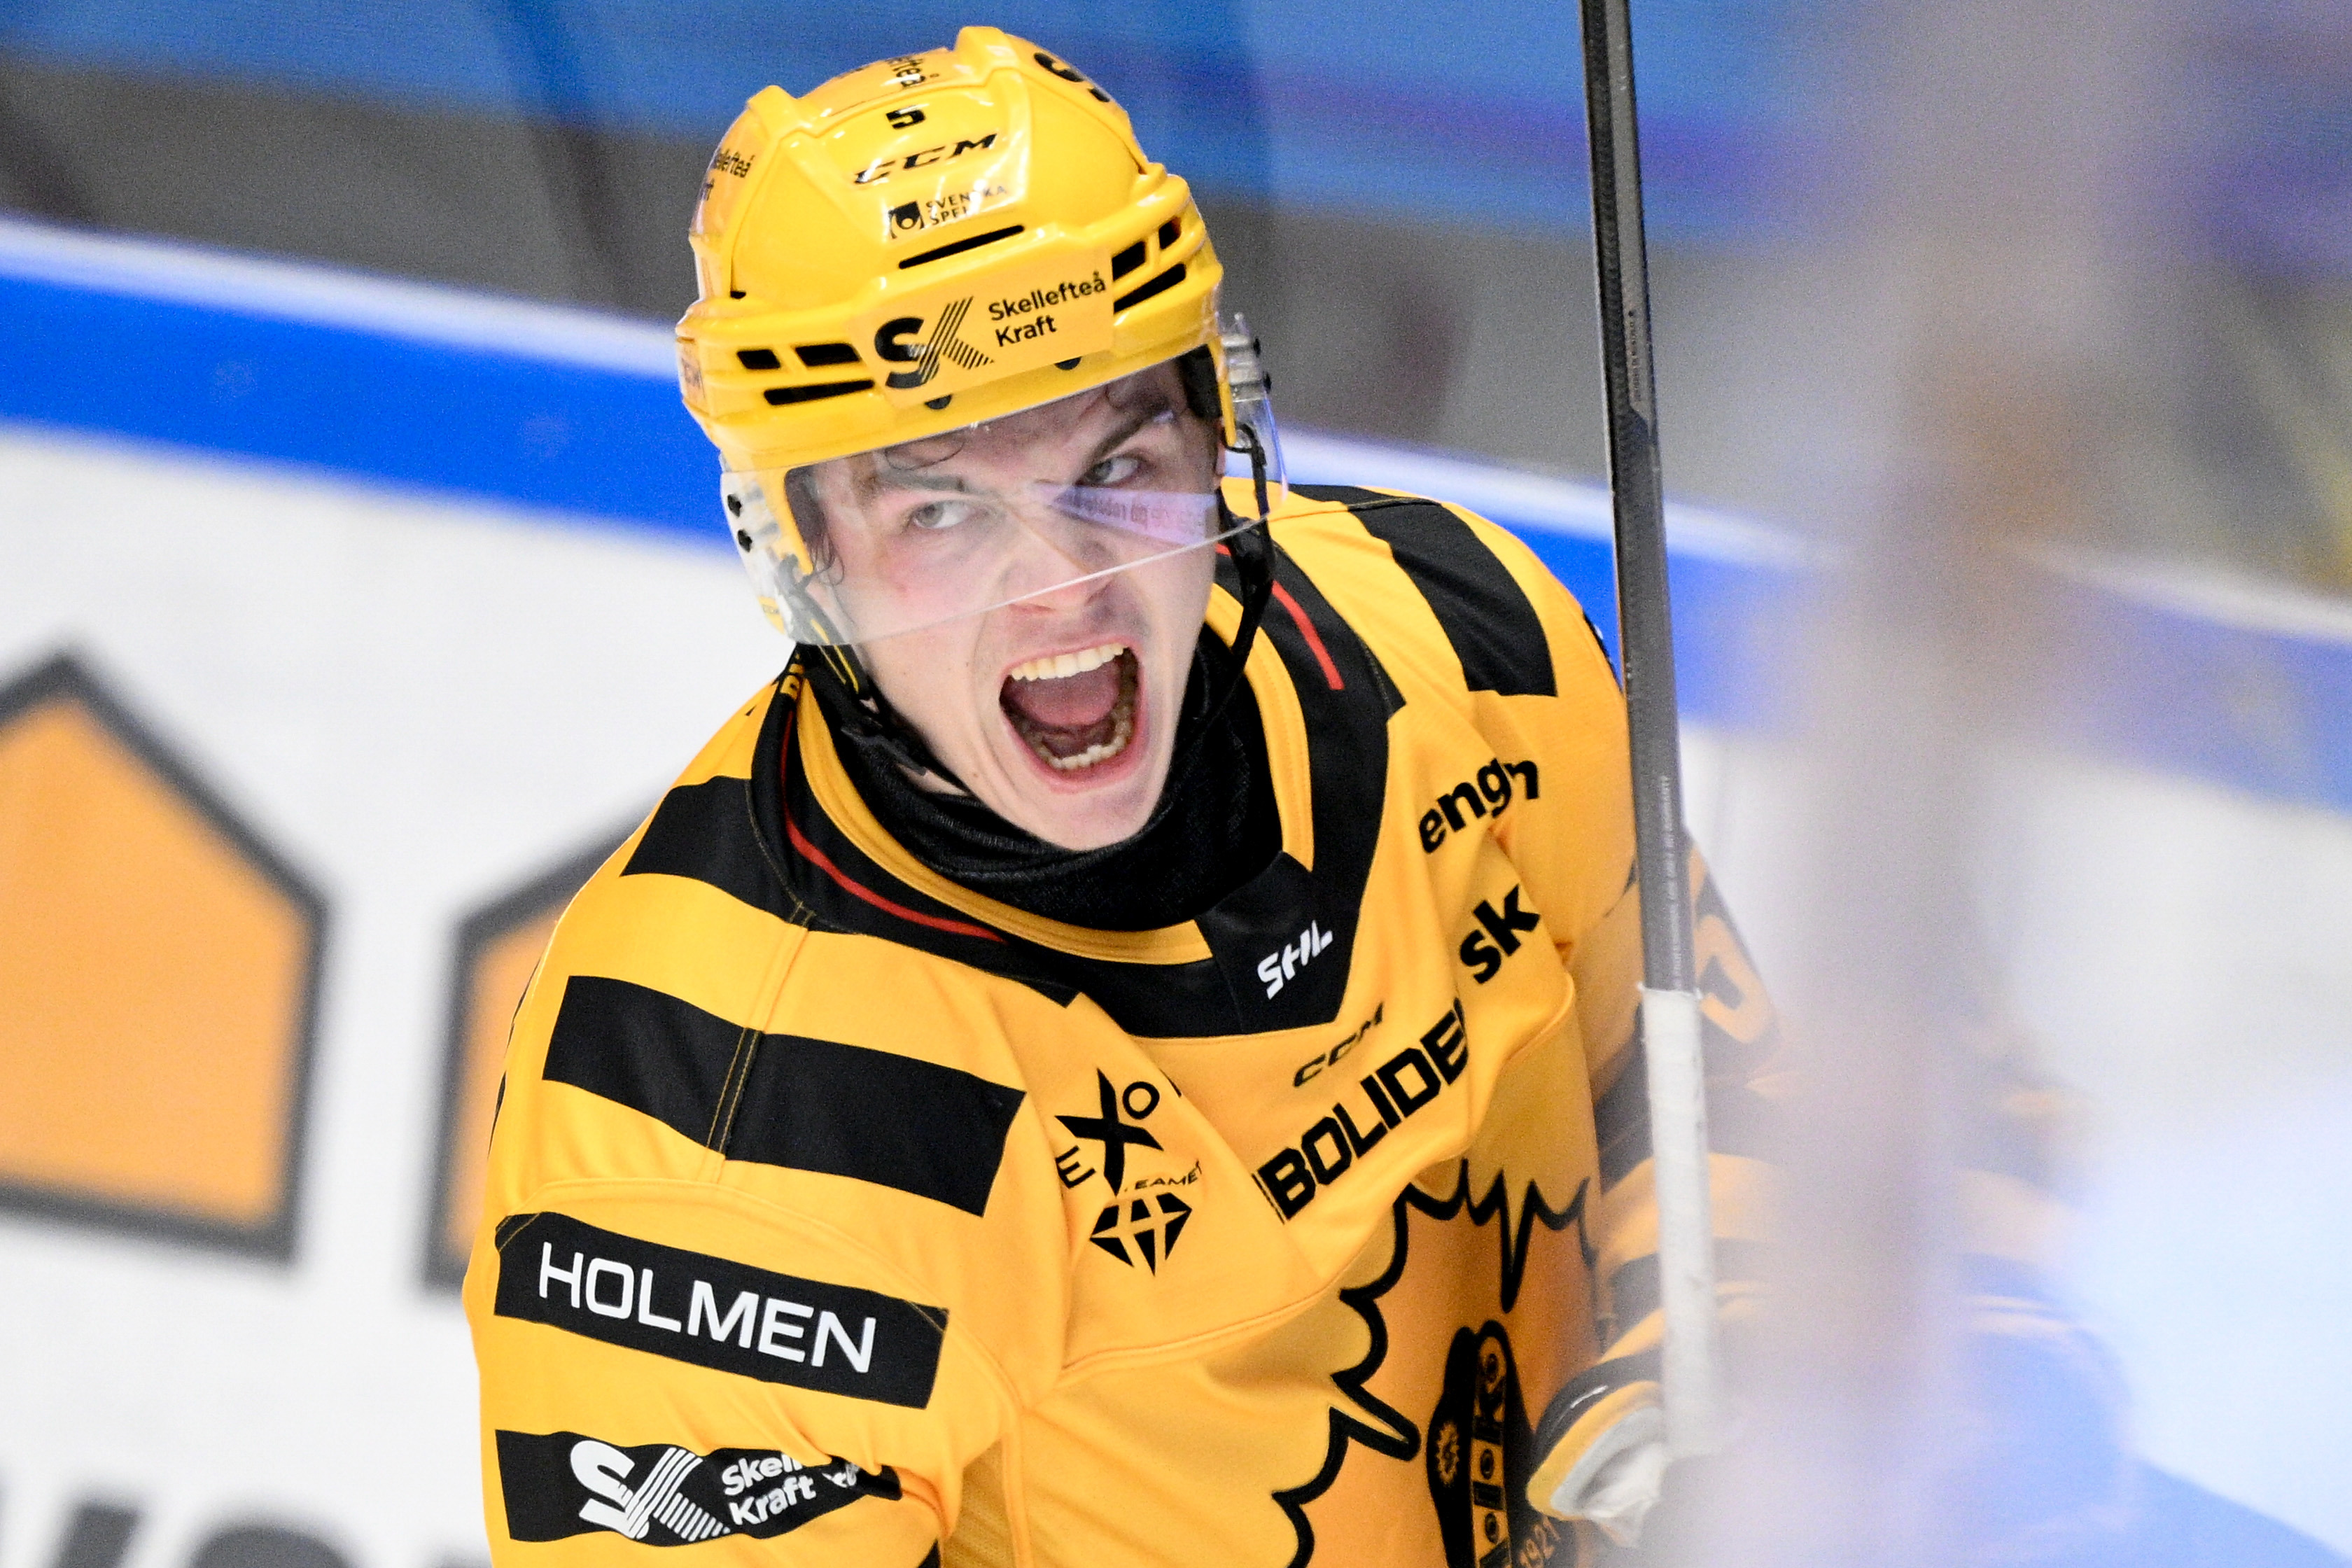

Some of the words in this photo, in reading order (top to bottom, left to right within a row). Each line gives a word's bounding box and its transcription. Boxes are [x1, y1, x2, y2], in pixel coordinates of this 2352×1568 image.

[886, 109, 925, 130] 5
[854, 133, 997, 185] CCM
[926, 185, 1007, 209] SVENKA
[988, 270, 1107, 321] Skellefteå
[995, 315, 1058, 347] Kraft
[1257, 919, 1333, 1000] SHL
[1257, 997, 1469, 1221] BOLIDE
[538, 1241, 877, 1374] HOLMEN
[729, 1475, 817, 1525] Kraft
